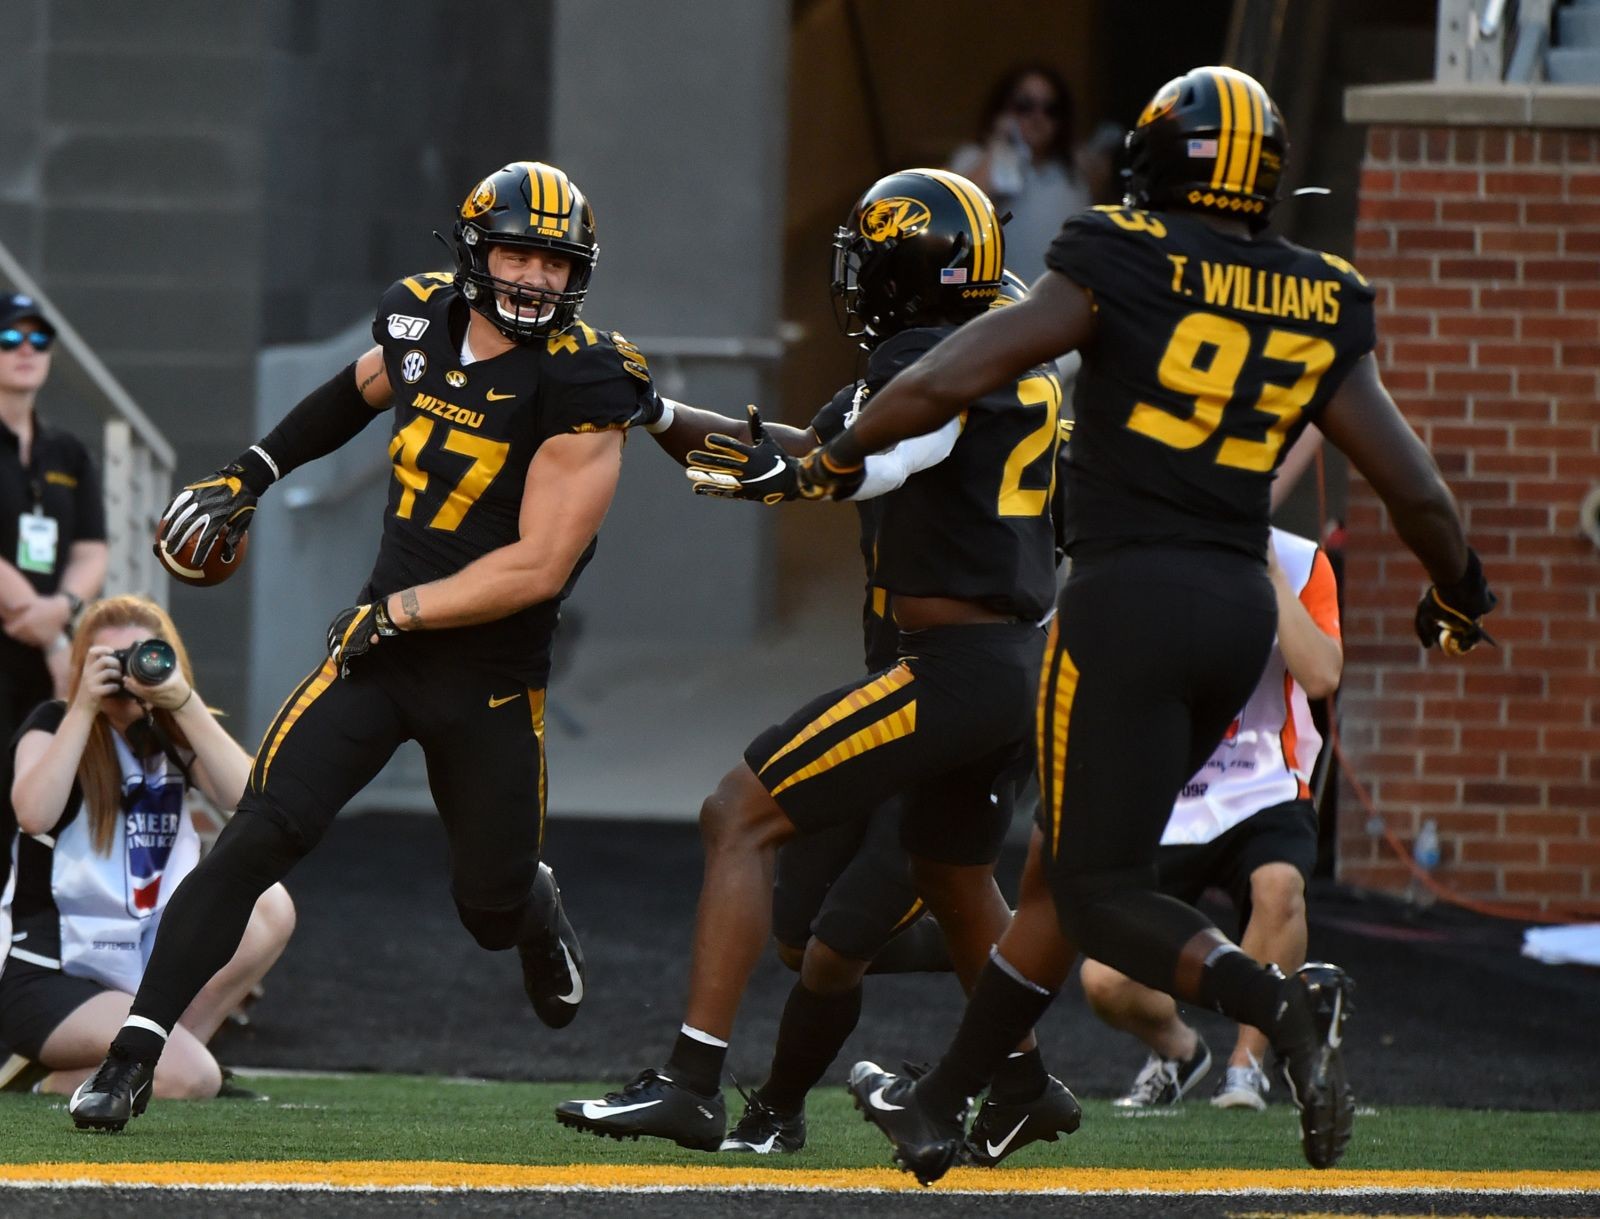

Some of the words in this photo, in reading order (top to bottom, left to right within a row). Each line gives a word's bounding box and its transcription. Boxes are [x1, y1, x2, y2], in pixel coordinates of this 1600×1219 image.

[537, 227, 565, 238] TIGERS
[1166, 253, 1193, 297] T.
[1200, 260, 1342, 325] WILLIAMS
[386, 313, 431, 341] 150
[402, 352, 425, 382] SEC
[1126, 312, 1336, 473] 93
[410, 392, 487, 429] MIZZOU
[997, 375, 1063, 517] 2
[387, 414, 511, 533] 47
